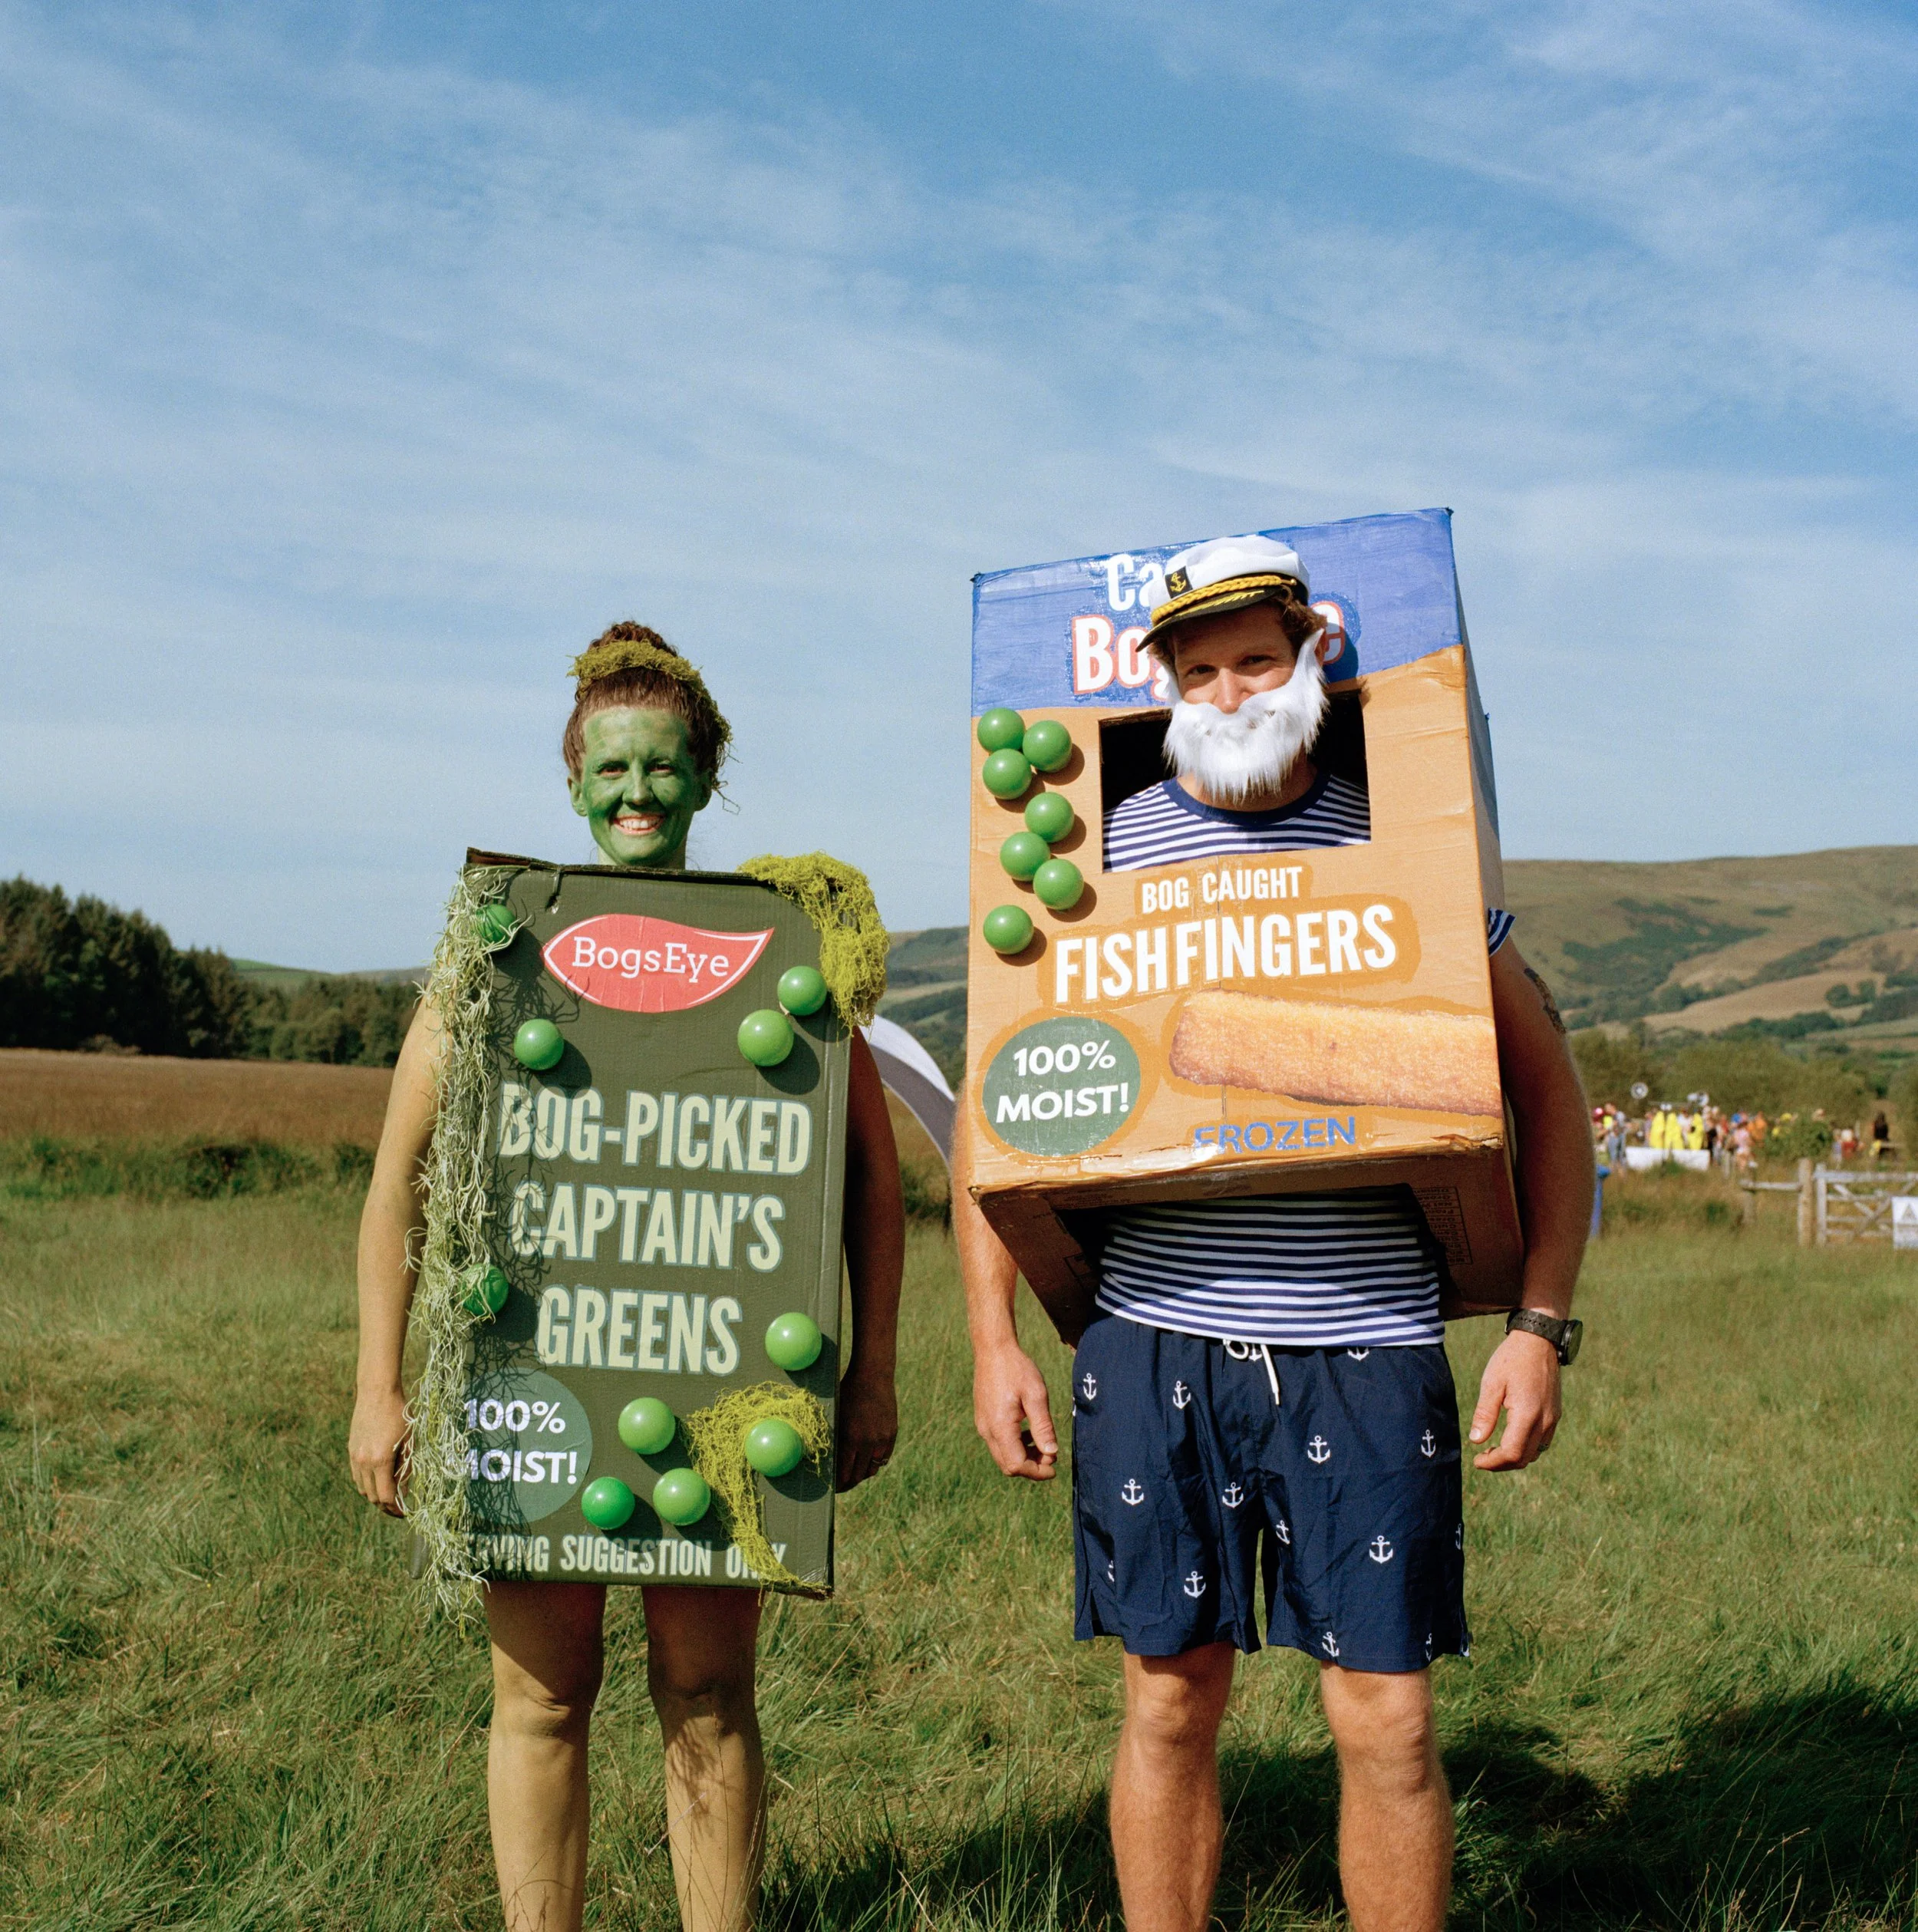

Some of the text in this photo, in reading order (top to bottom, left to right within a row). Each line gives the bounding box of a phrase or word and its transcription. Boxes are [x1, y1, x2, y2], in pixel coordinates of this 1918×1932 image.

[1142, 866, 1303, 914] BOG CAUGHT
[572, 935, 730, 983] BogsEye
[1013, 1039, 1116, 1076] 100%
[995, 1081, 1130, 1123] MOIST!
[498, 1082, 813, 1176] BOG-PICKED
[1194, 1115, 1356, 1154] FROZEN
[509, 1182, 786, 1271] CAPTAIN'S
[536, 1285, 743, 1376] GREENS
[463, 1398, 566, 1434] 100%
[560, 1535, 712, 1577] SUGGESTION
[726, 1542, 787, 1580] OY
